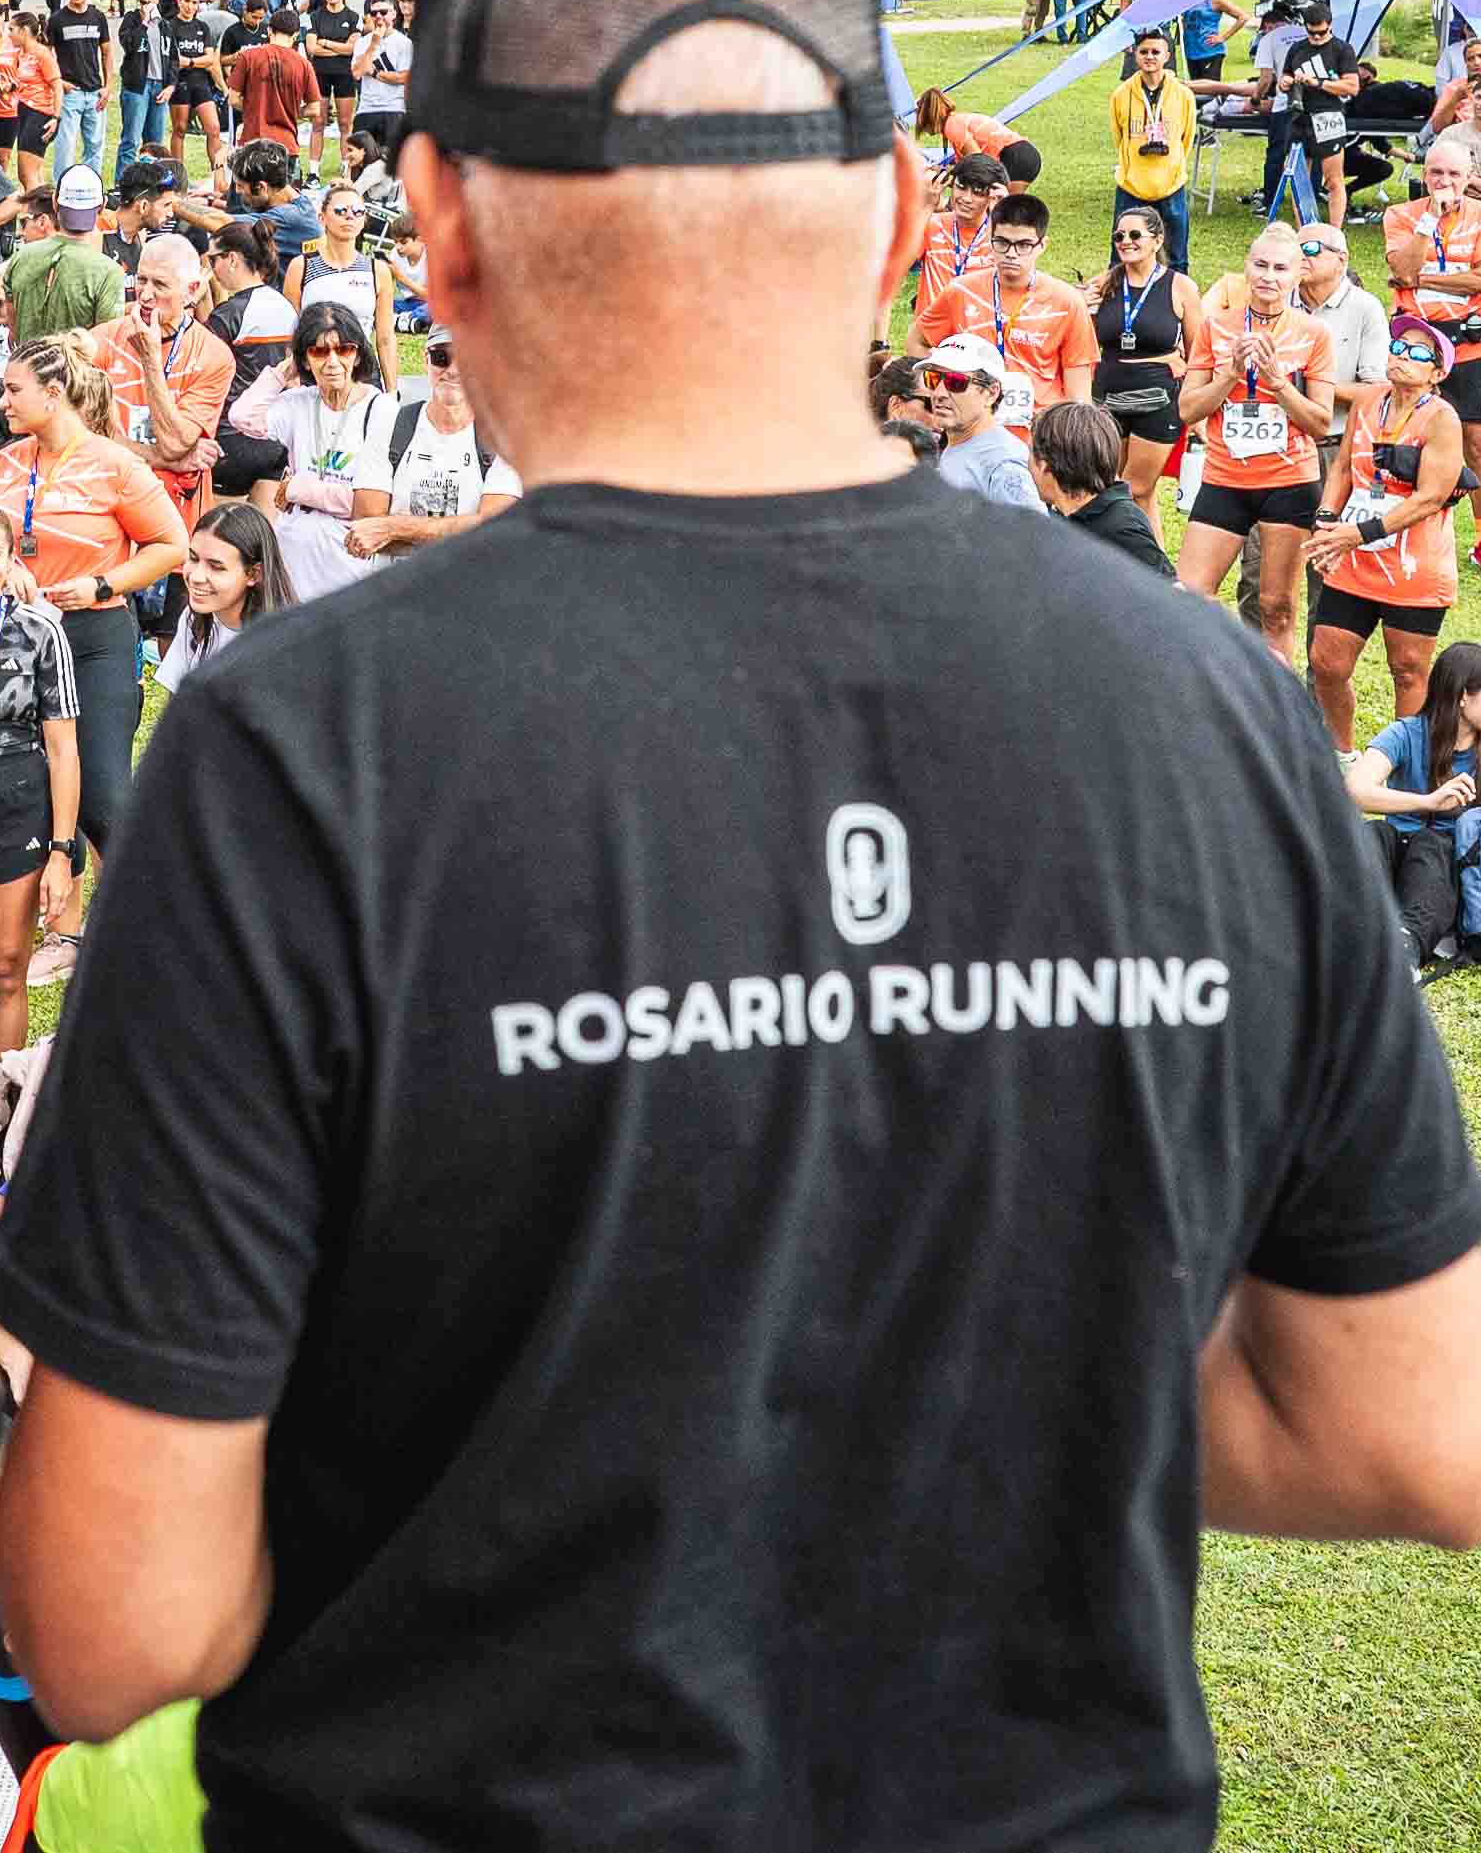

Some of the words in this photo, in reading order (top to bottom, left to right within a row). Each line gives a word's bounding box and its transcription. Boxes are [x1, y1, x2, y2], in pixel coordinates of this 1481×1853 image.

[1225, 422, 1285, 440] 5262
[491, 970, 855, 1076] ROSARIO
[869, 956, 1232, 1036] RUNNING
